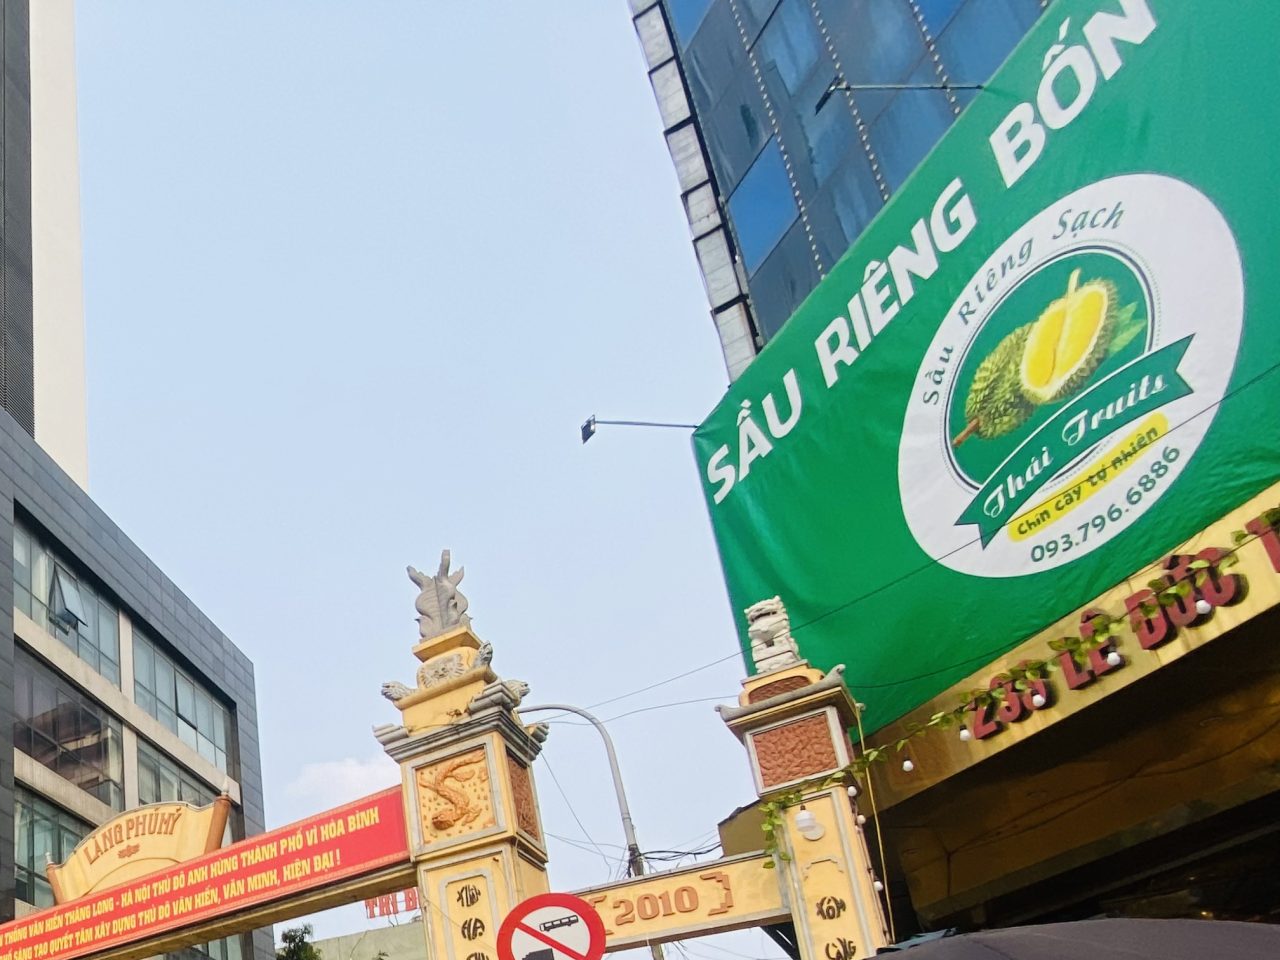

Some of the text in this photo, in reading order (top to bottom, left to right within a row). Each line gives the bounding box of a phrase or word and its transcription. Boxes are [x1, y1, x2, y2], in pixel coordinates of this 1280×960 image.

[707, 0, 1157, 505] SẦU RIÊNG BỐN
[922, 201, 1124, 405] Sầu Riêng Sạch
[983, 446, 1053, 518] Thái
[1111, 426, 1159, 470] nhiên
[1030, 446, 1180, 563] 093.796.6886
[4, 925, 28, 945] THỐNG
[28, 920, 44, 936] VĂN
[45, 911, 63, 932] HIẾN
[92, 897, 114, 916] LONG
[121, 888, 133, 908] HÀ
[135, 883, 151, 904] NỘI
[153, 875, 171, 897] THỦ
[172, 871, 185, 891] ĐÔ
[187, 865, 208, 886] ANH
[210, 854, 238, 878] HÙNG
[240, 841, 277, 867] THÀNH
[280, 828, 303, 856] PHỐ
[305, 825, 319, 847] VÌ
[320, 818, 345, 842] HÒA
[347, 806, 380, 833] BÌNH
[83, 823, 124, 865] LÀNG
[126, 807, 159, 839] PHÚ
[33, 940, 48, 959] TẠO
[49, 930, 74, 955] QUYẾT
[75, 927, 93, 946] TÂM
[94, 921, 111, 940] XÂY
[112, 913, 136, 936] DỰNG
[138, 904, 156, 926] THỦ
[158, 901, 170, 920] ĐÔ
[172, 896, 192, 916] VĂN
[194, 885, 221, 909] HIẾN,
[223, 878, 245, 899] VĂN
[247, 869, 280, 893] MINH,
[283, 856, 310, 881] HIỆN
[313, 850, 334, 872] ĐẠI
[613, 886, 699, 926] 2010
